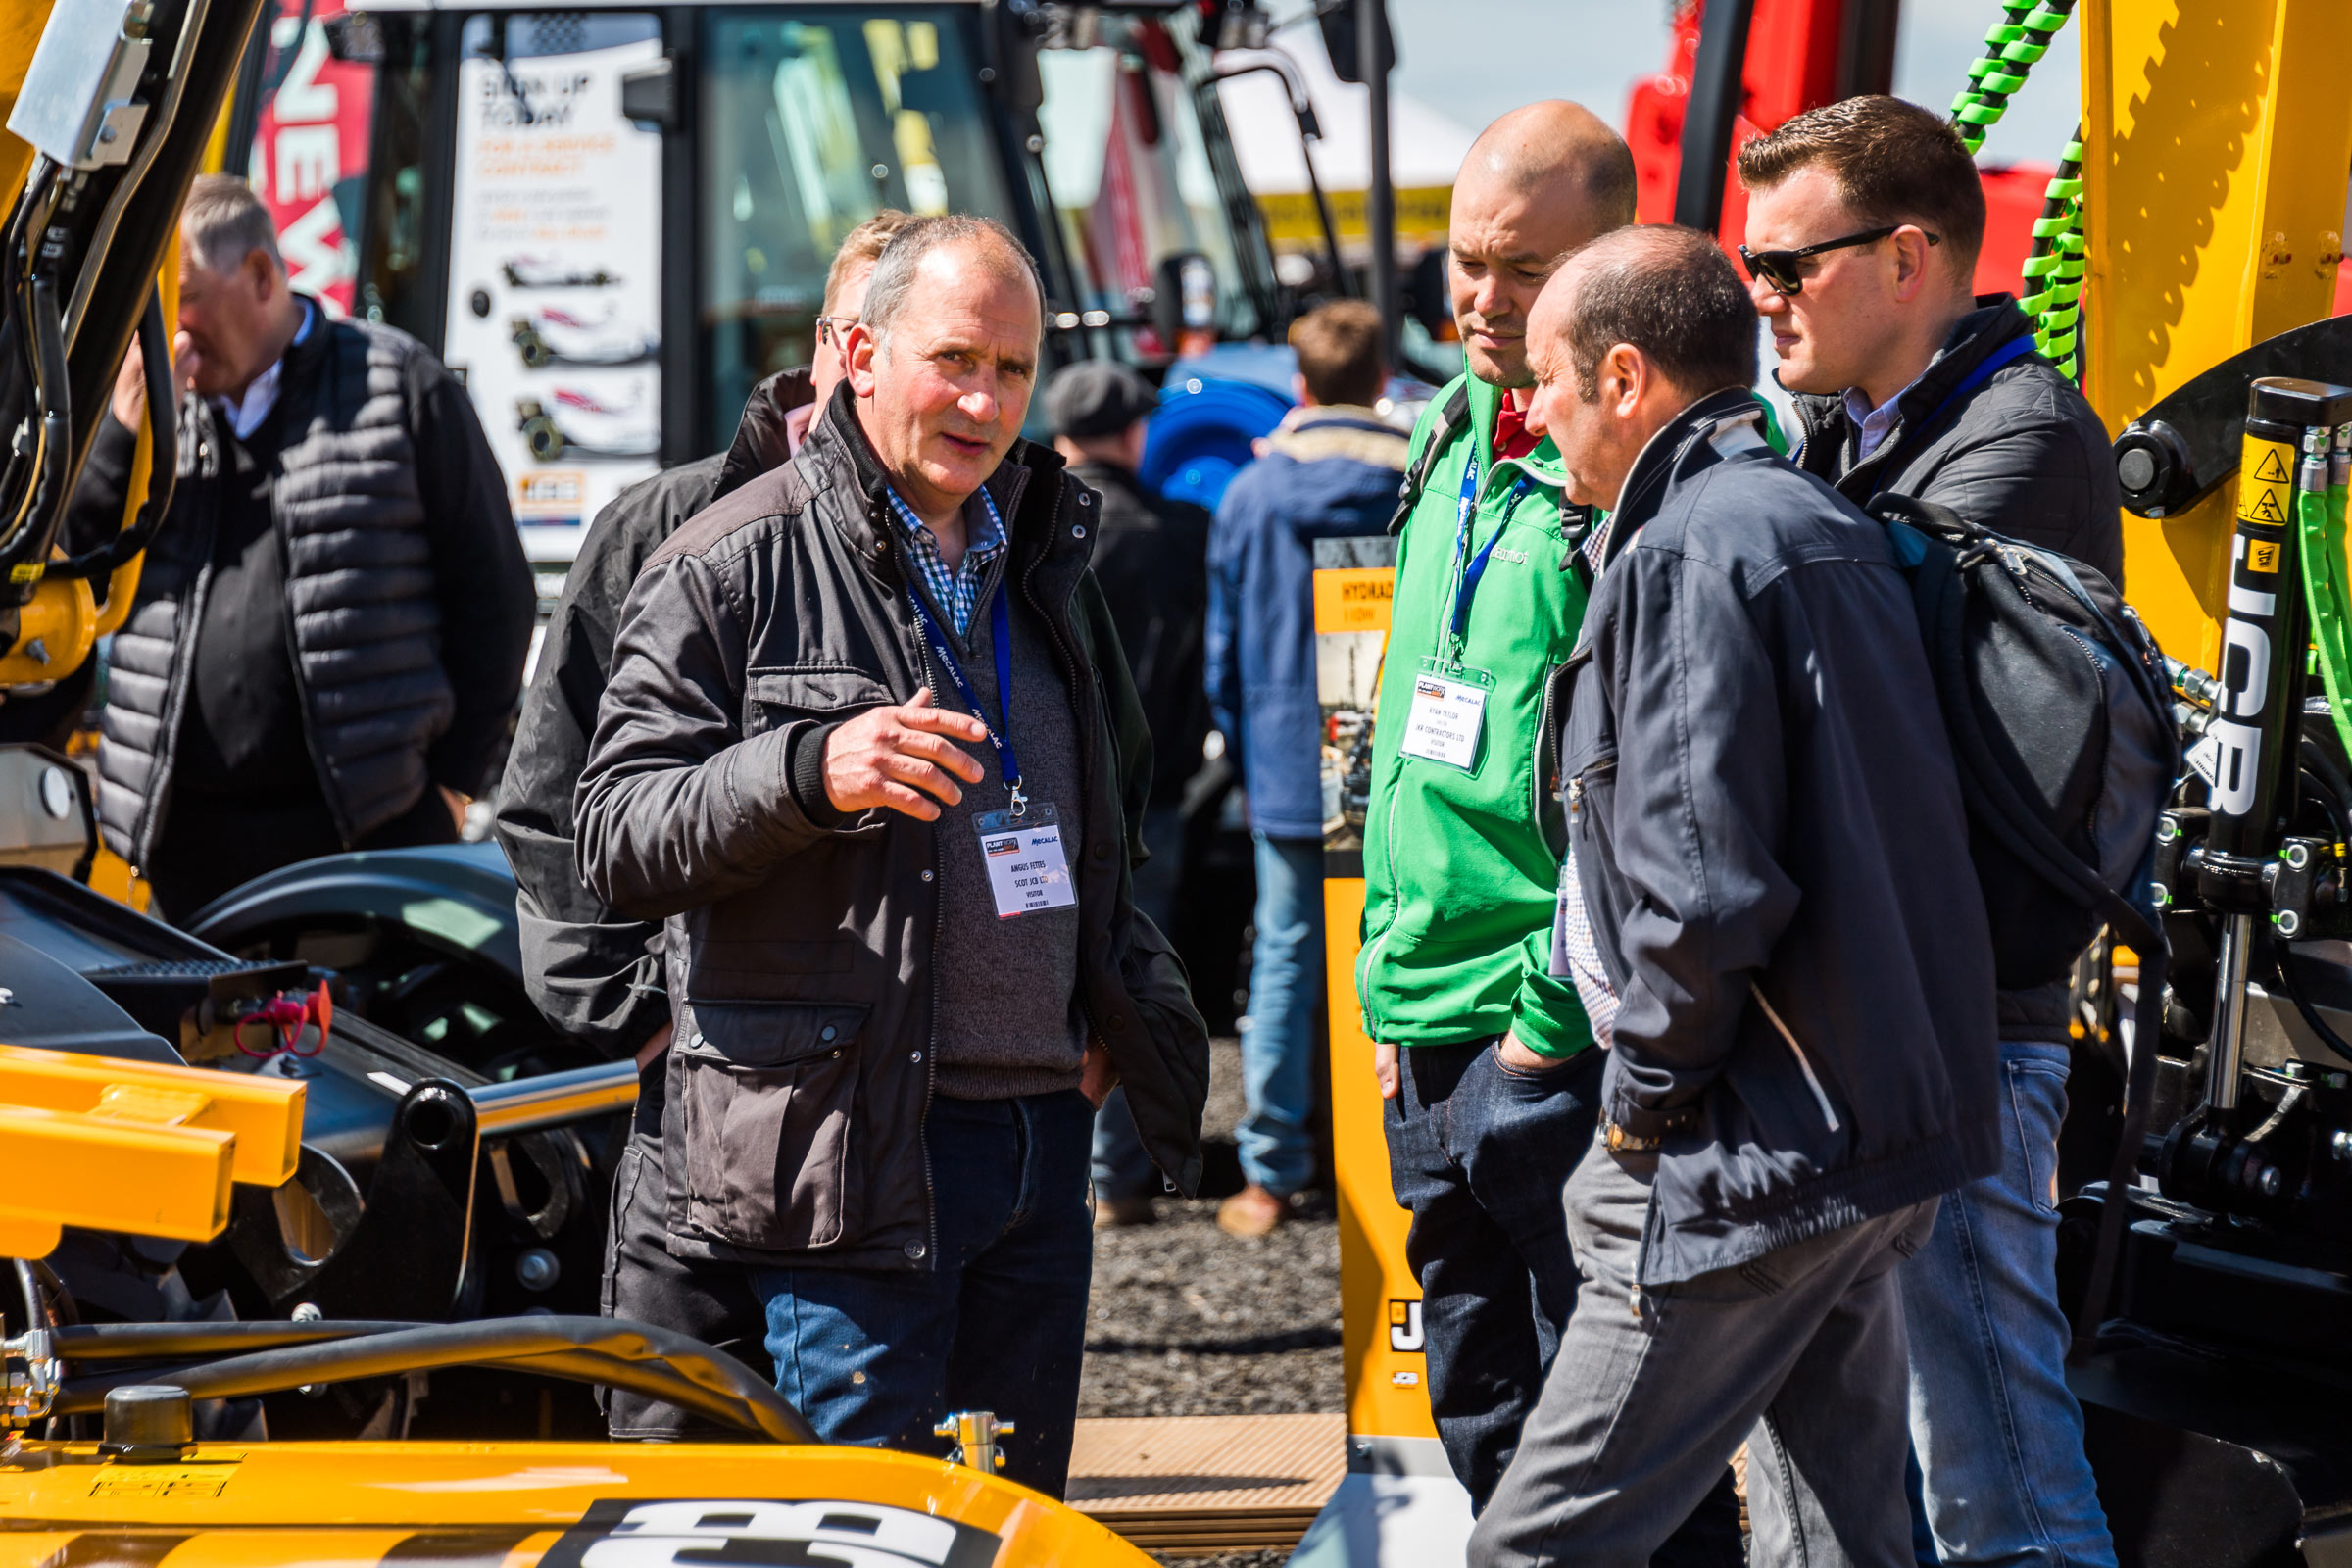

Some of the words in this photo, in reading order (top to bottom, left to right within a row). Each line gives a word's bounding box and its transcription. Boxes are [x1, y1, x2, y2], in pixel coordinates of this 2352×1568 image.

[2257, 549, 2273, 567] JCB
[2210, 533, 2276, 815] JCB
[1425, 726, 1455, 740] CONTRACTORS
[1010, 862, 1029, 873] ANGUS
[1014, 879, 1028, 888] SCOT
[1029, 877, 1039, 886] JCB
[1026, 889, 1043, 898] VISITOR
